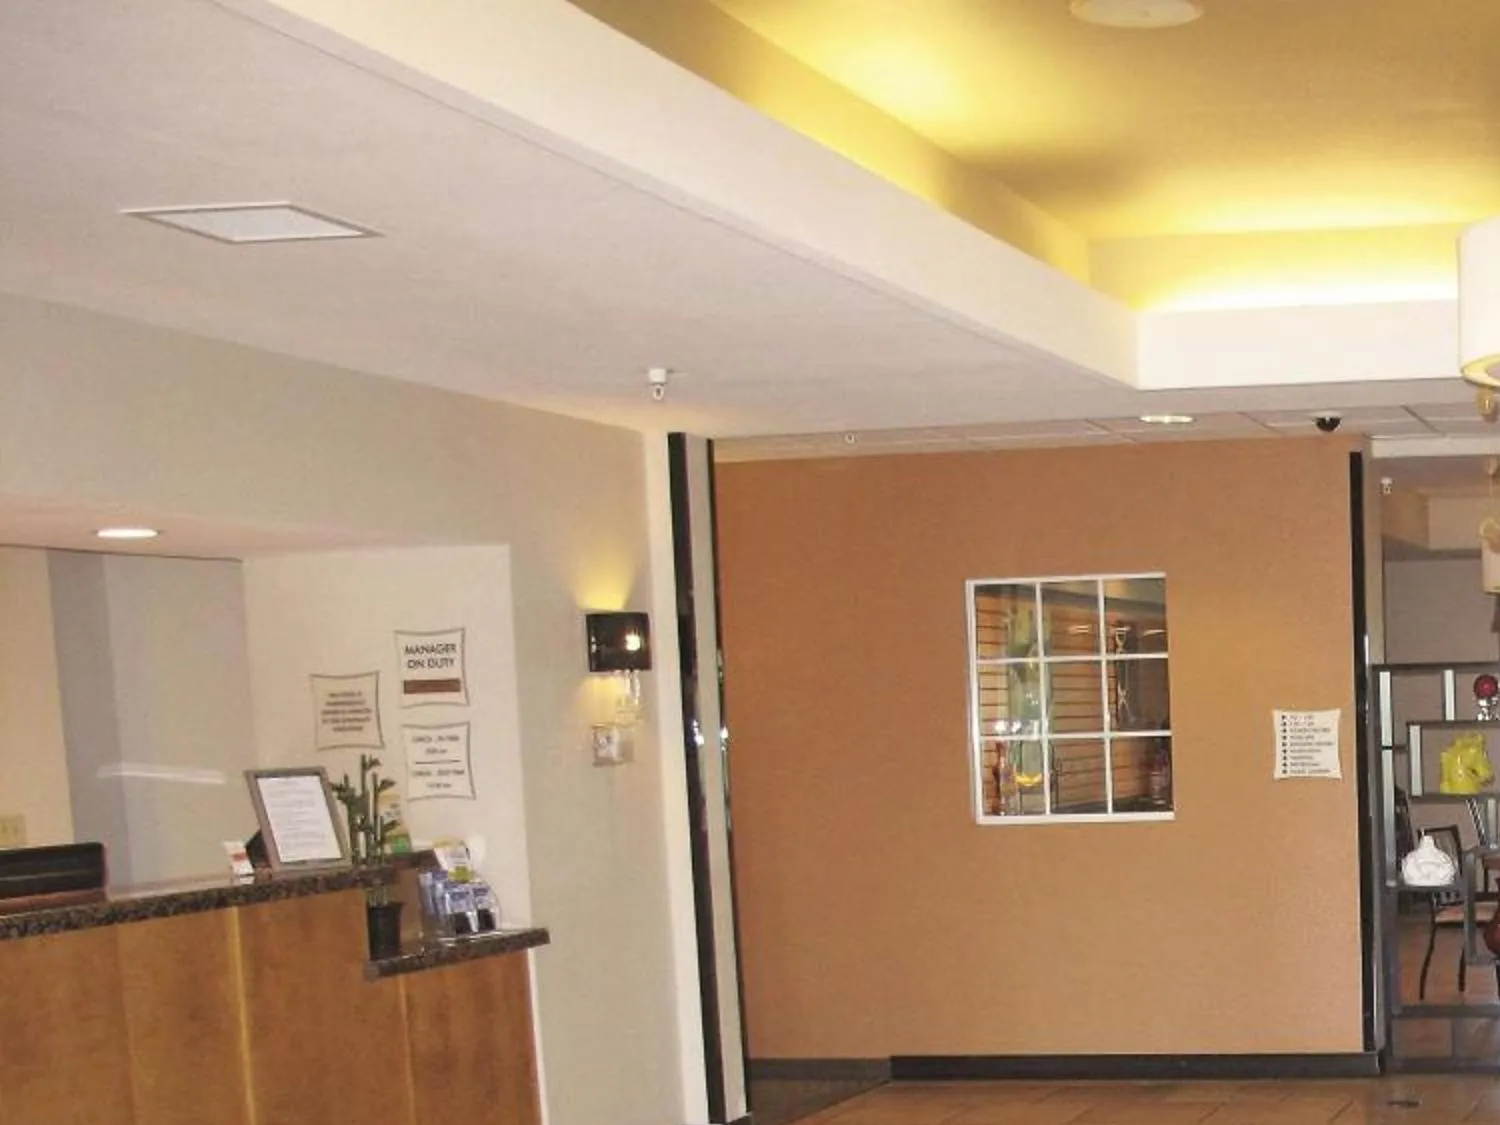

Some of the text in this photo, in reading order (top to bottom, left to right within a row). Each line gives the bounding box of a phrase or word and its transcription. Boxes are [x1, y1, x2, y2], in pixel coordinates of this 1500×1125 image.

[404, 643, 456, 655] MANAGER
[407, 658, 454, 670] ON DUTY
